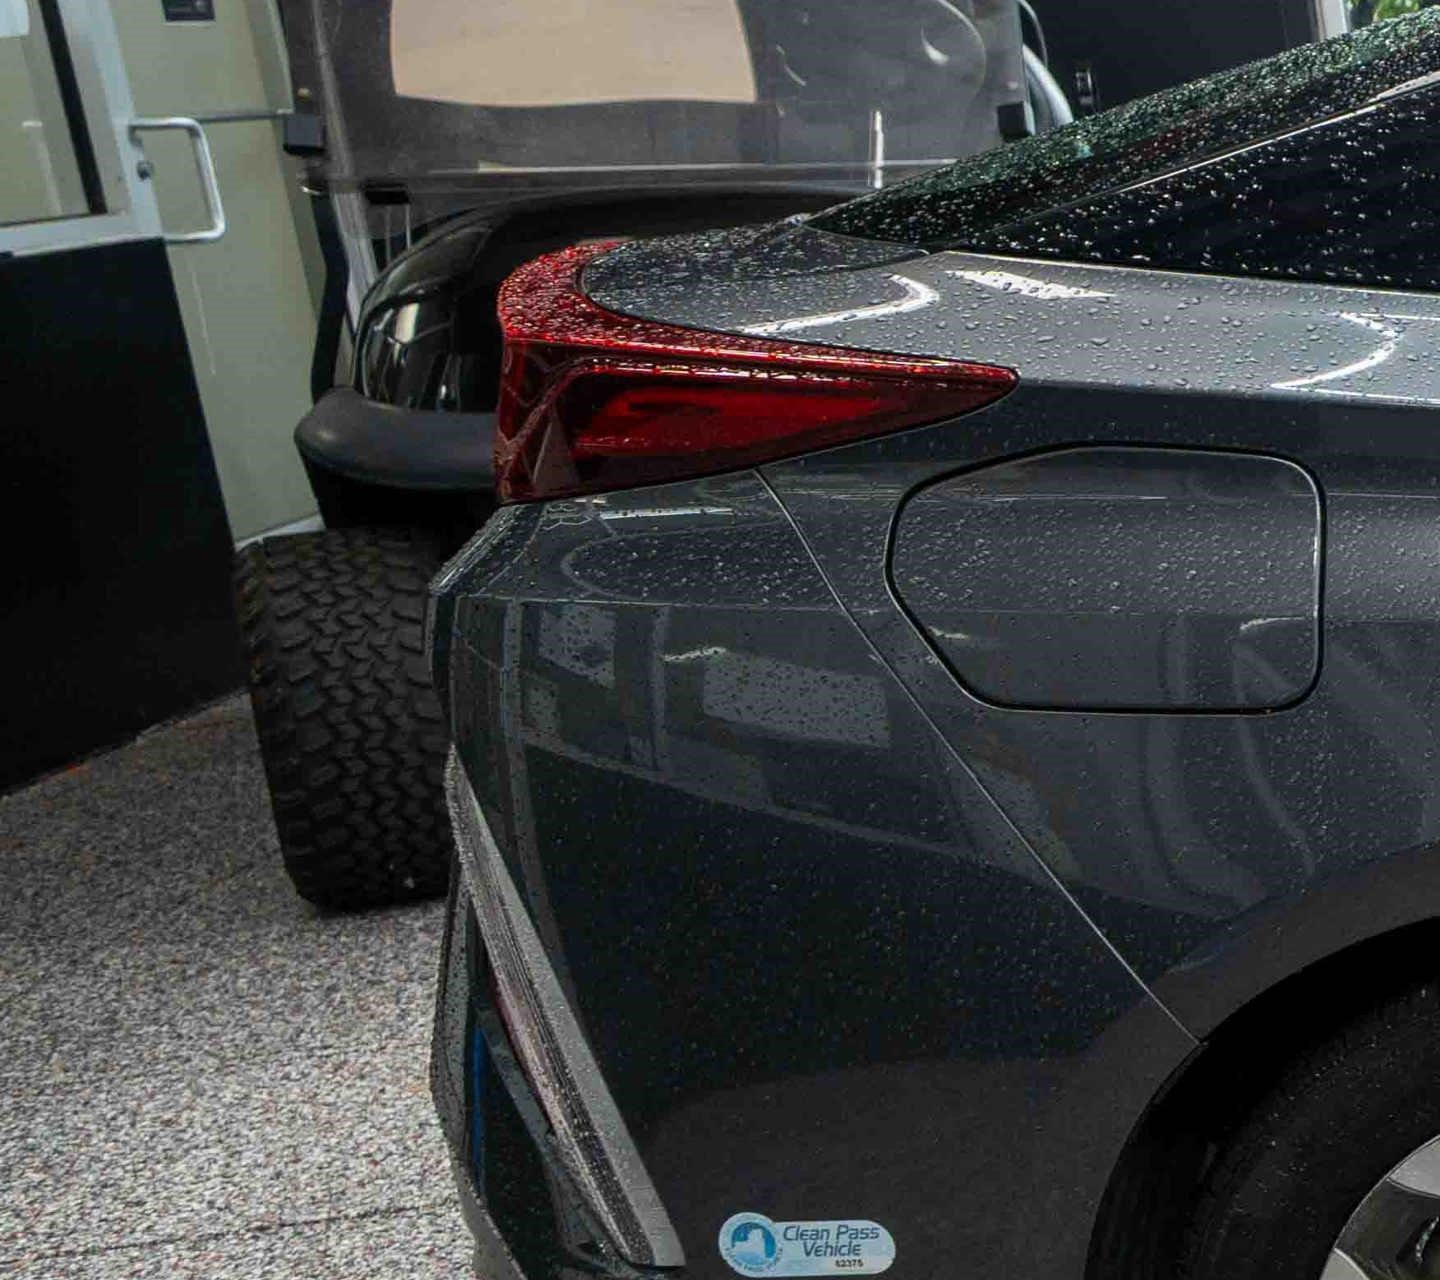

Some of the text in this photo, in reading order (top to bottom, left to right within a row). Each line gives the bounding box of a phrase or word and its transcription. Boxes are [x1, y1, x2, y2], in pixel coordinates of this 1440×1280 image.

[783, 1224, 881, 1241] Clean Pass
[803, 1241, 862, 1257] Vehicle
